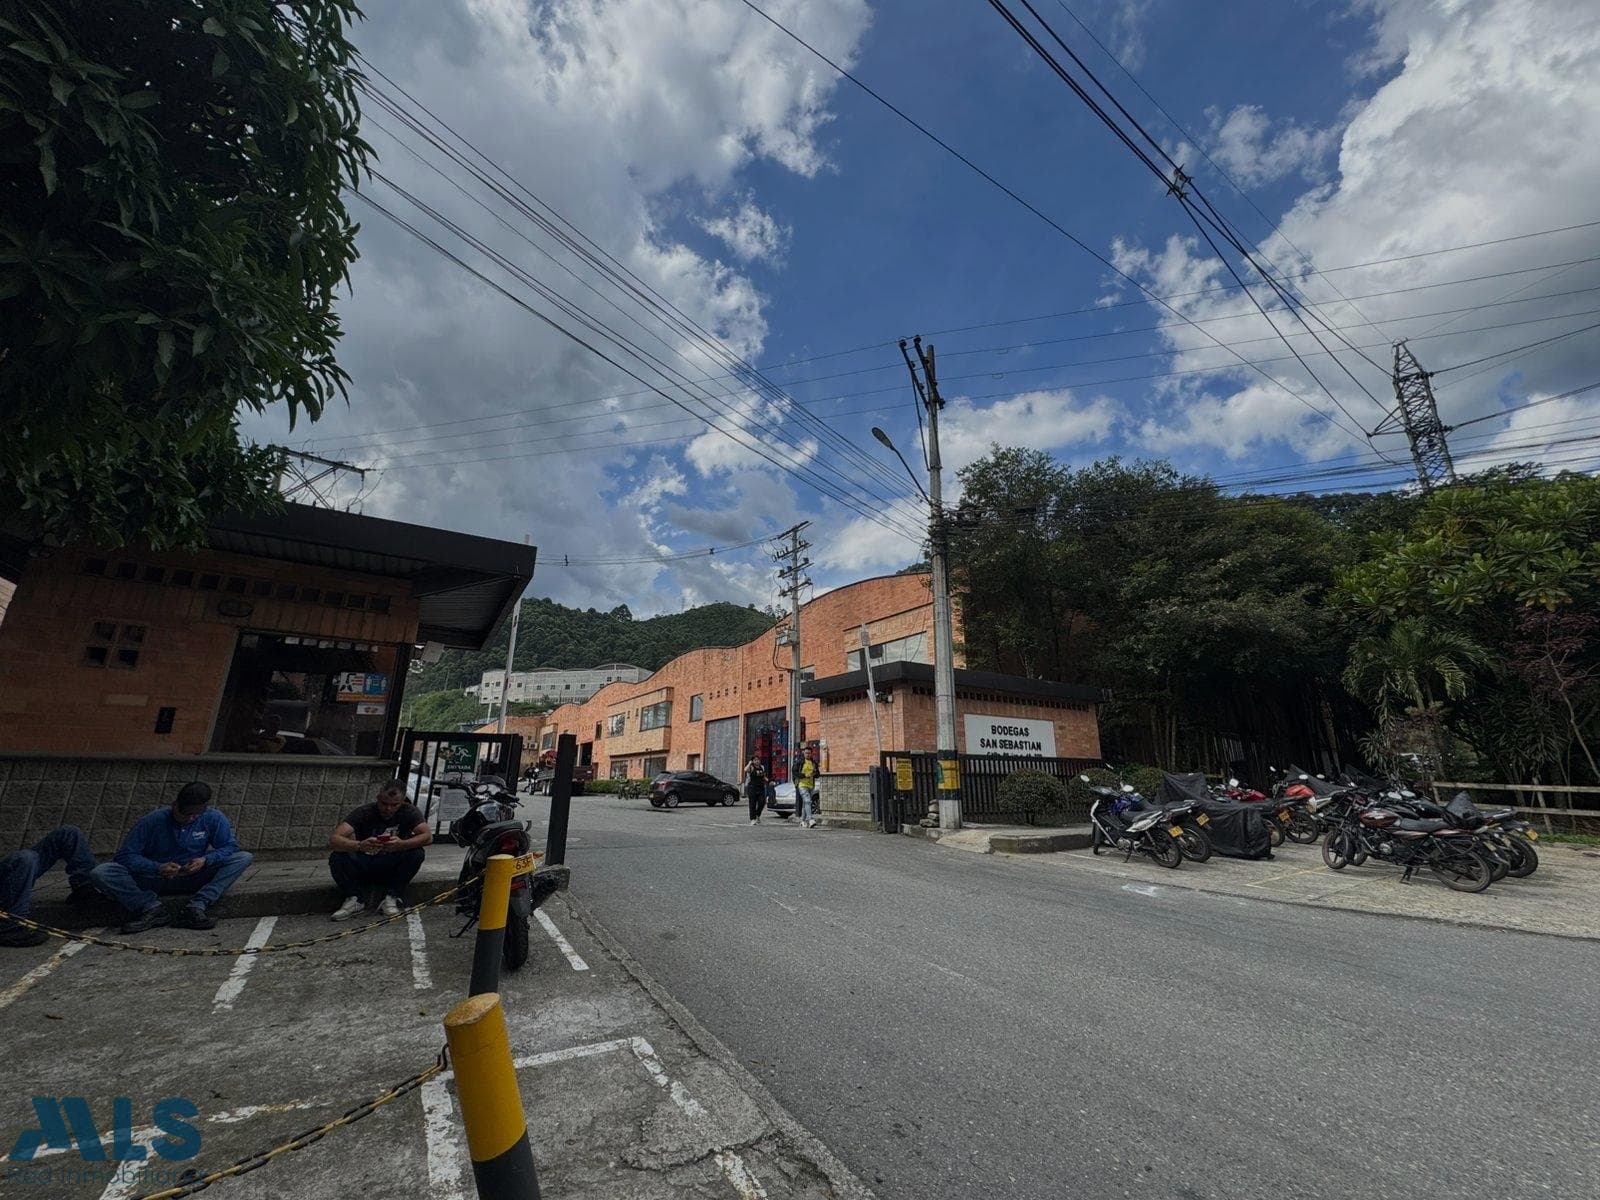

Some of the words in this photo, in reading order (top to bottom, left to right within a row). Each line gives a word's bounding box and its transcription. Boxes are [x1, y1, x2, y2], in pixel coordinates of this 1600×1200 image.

[991, 725, 1030, 737] BODEGAS
[980, 738, 998, 749] SAN
[999, 739, 1042, 751] SEBASTIAN
